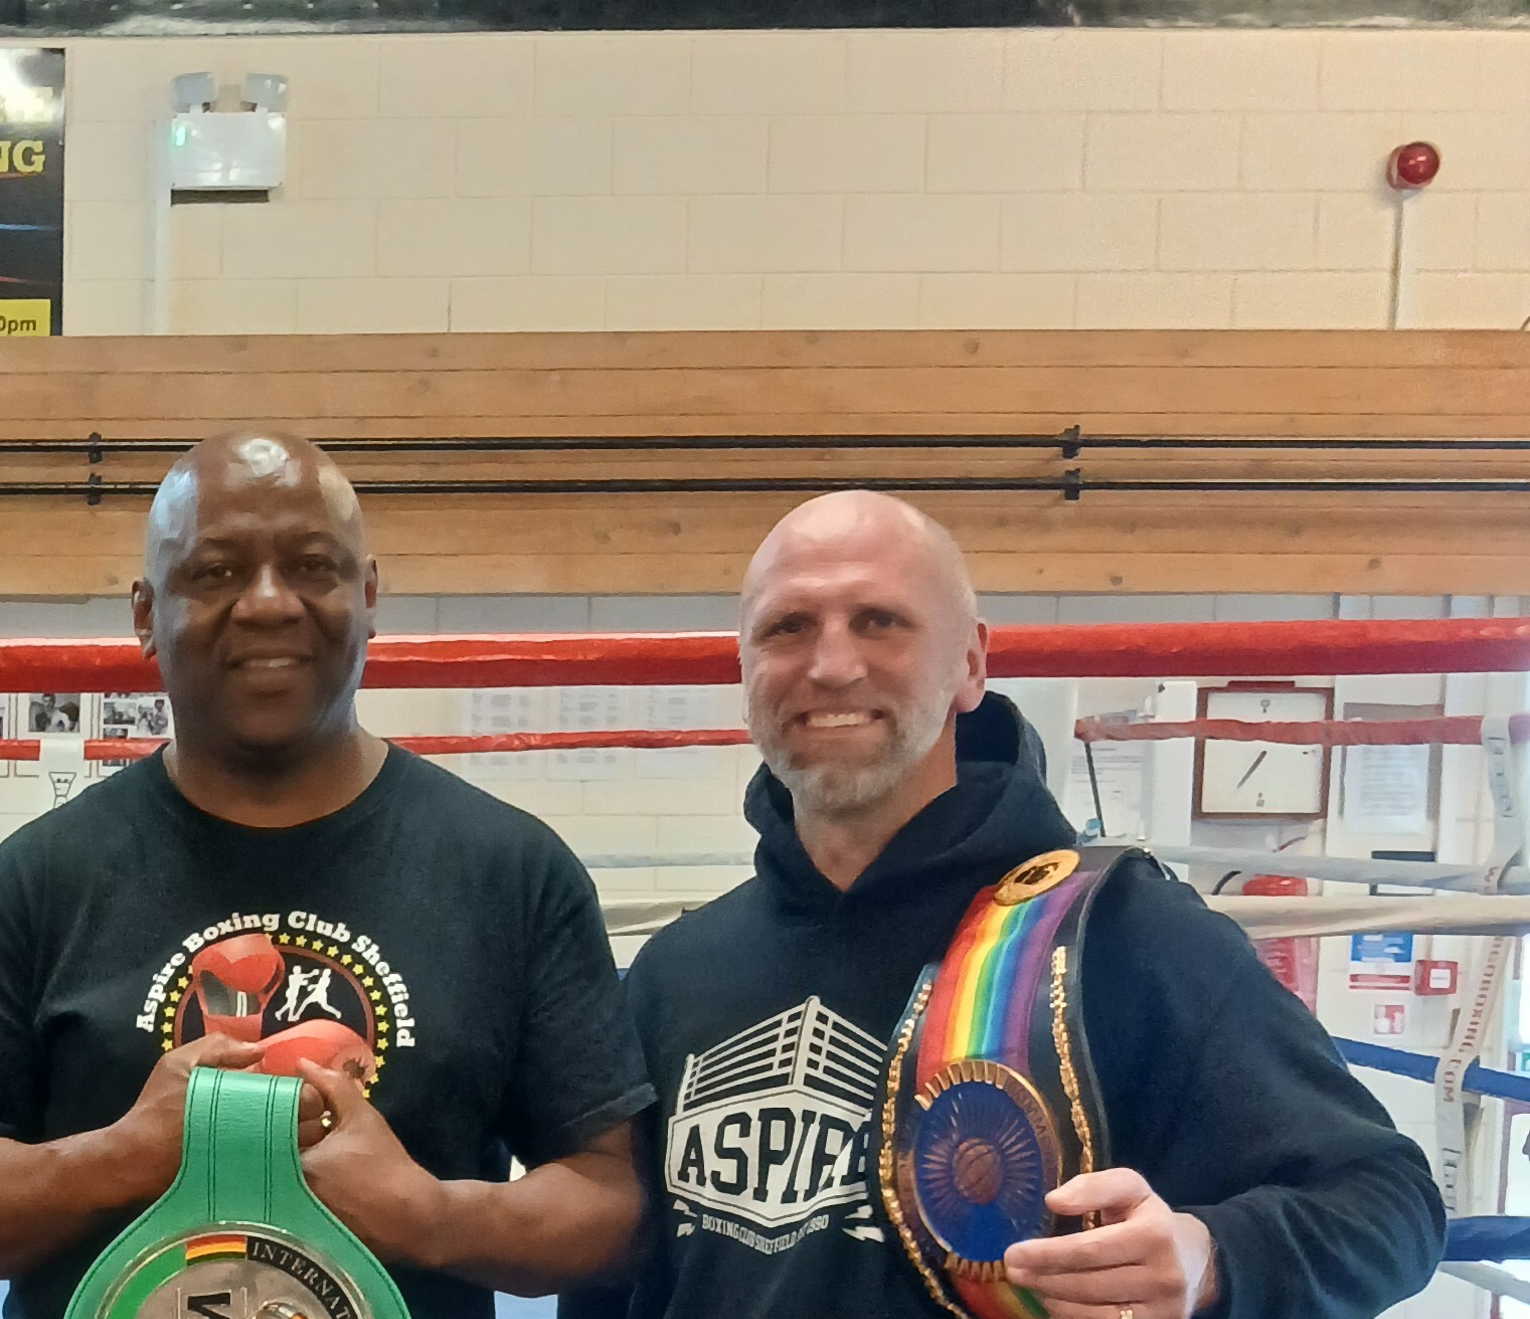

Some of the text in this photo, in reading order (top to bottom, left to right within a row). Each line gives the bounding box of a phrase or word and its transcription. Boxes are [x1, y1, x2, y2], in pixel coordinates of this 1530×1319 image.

[135, 910, 416, 1048] Aspire Boxing Club Sheffield
[701, 1213, 740, 1239] BOXING
